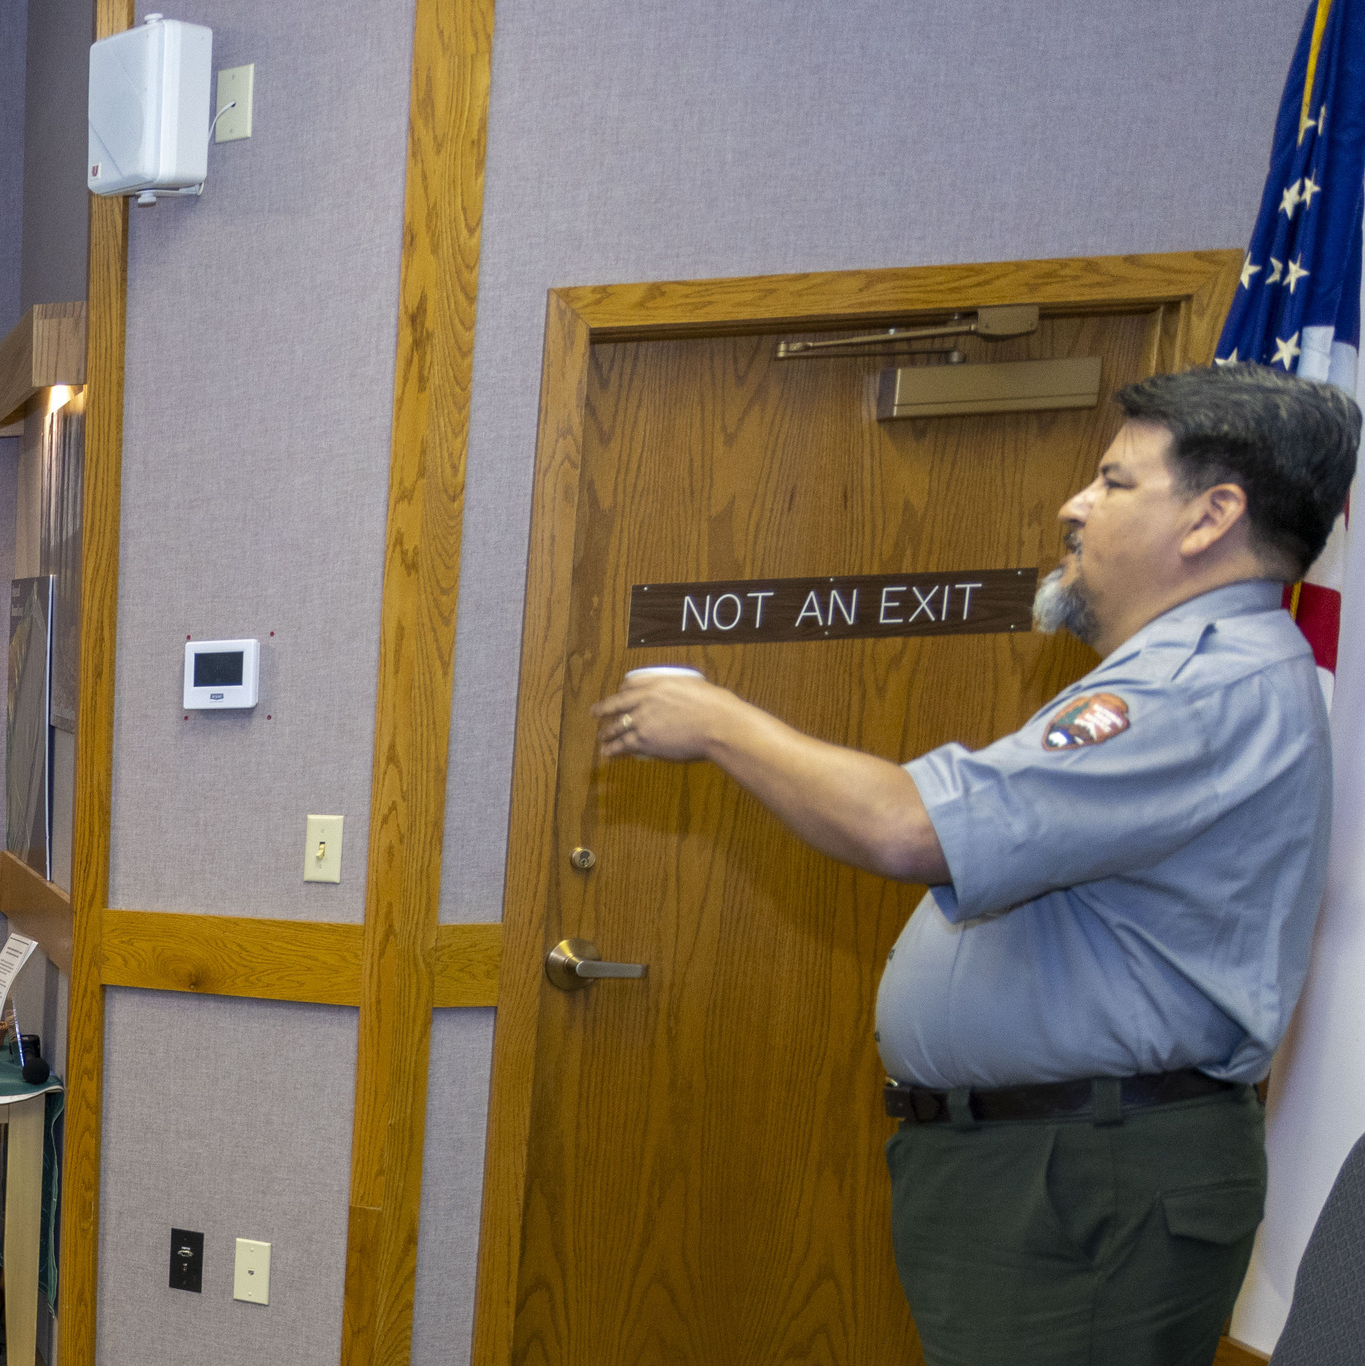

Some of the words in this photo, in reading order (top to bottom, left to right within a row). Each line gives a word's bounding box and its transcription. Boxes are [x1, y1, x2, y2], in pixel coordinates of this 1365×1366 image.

[681, 592, 774, 631] NOT
[795, 589, 857, 627] AN
[879, 583, 982, 623] EXIT
